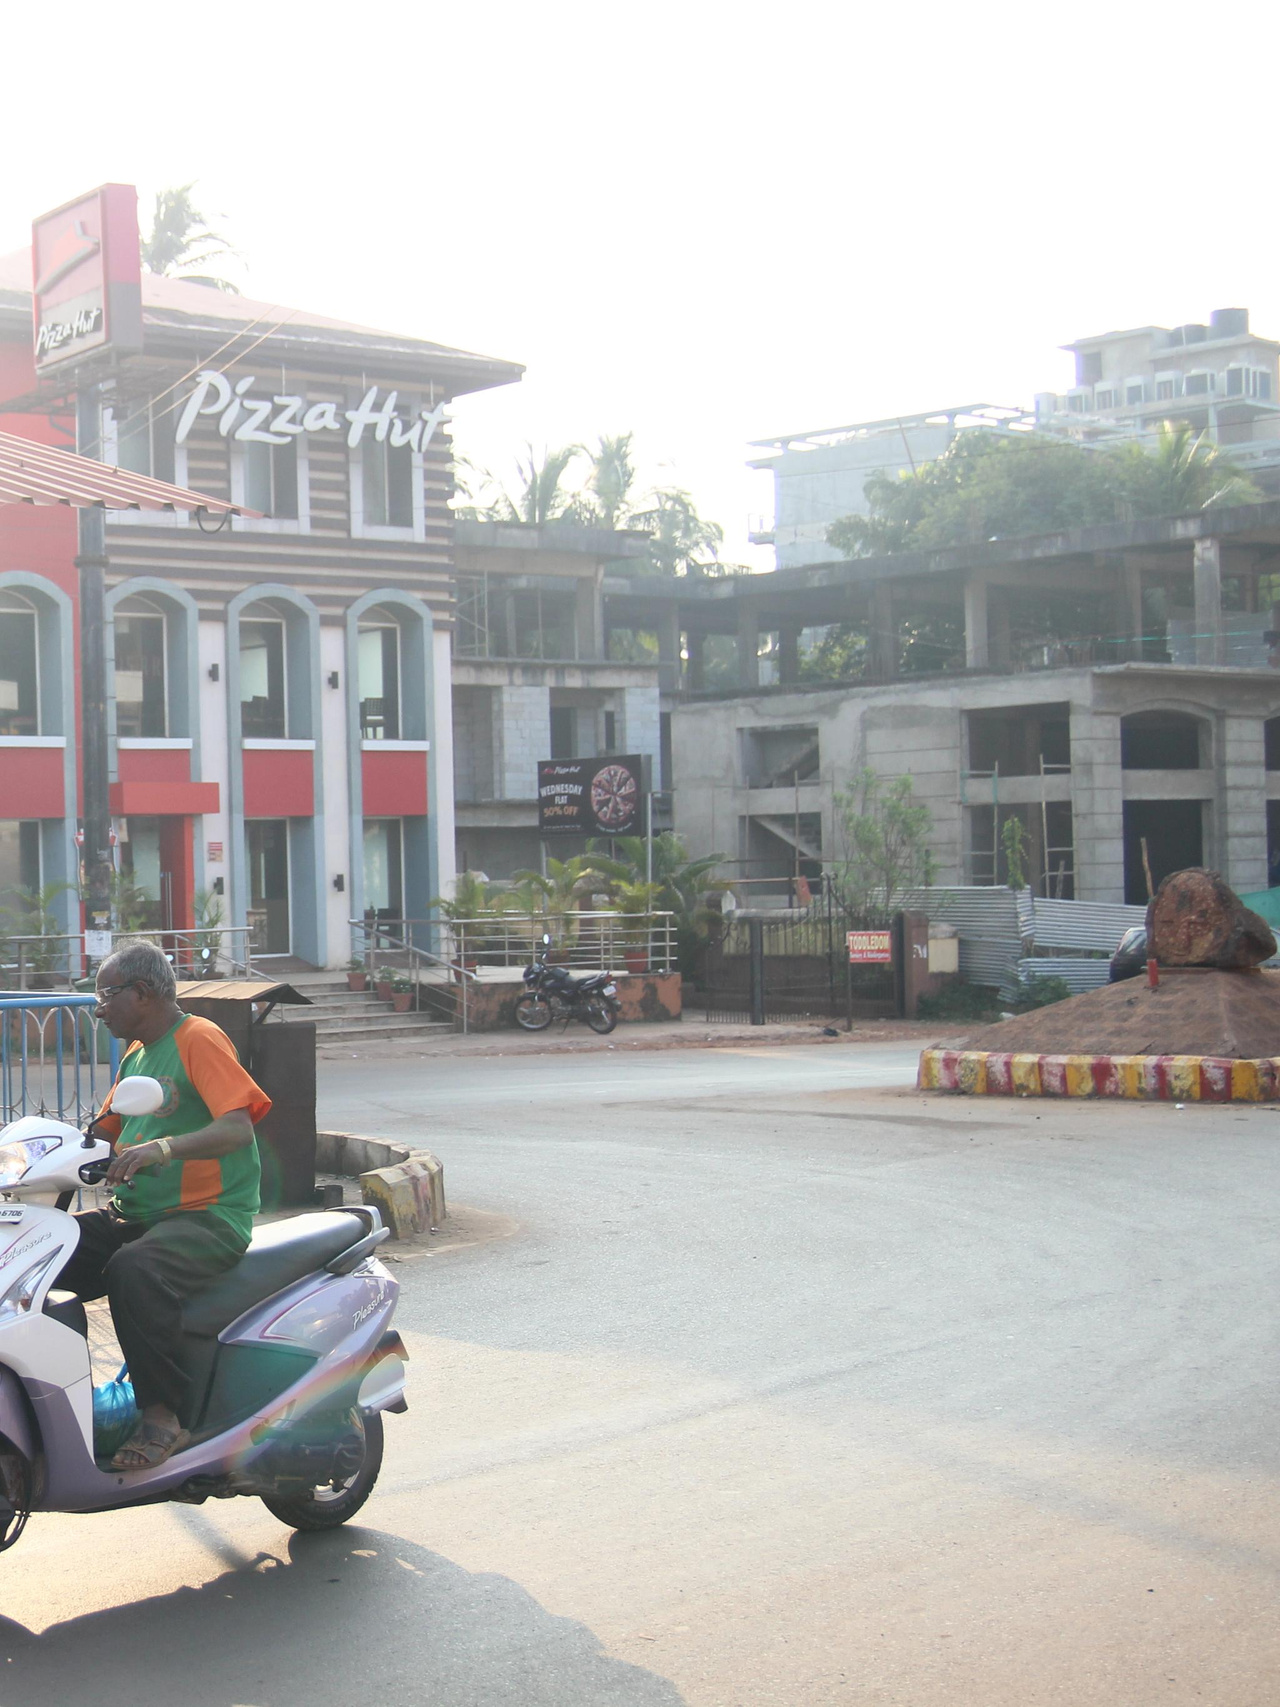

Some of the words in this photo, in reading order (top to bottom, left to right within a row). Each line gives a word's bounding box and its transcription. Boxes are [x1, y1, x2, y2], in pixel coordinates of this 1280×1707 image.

[35, 322, 72, 356] Pizza
[72, 306, 102, 339] Hut
[175, 369, 341, 445] Pizza
[345, 385, 452, 453] Hut
[540, 783, 583, 798] WEDNESDAY
[555, 795, 569, 804] FLAT
[543, 806, 563, 817] 50%
[563, 805, 580, 816] OFF
[849, 935, 889, 950] TODDLEDOM
[1, 1232, 52, 1267] Pleasure
[352, 1290, 385, 1330] Pleasure
